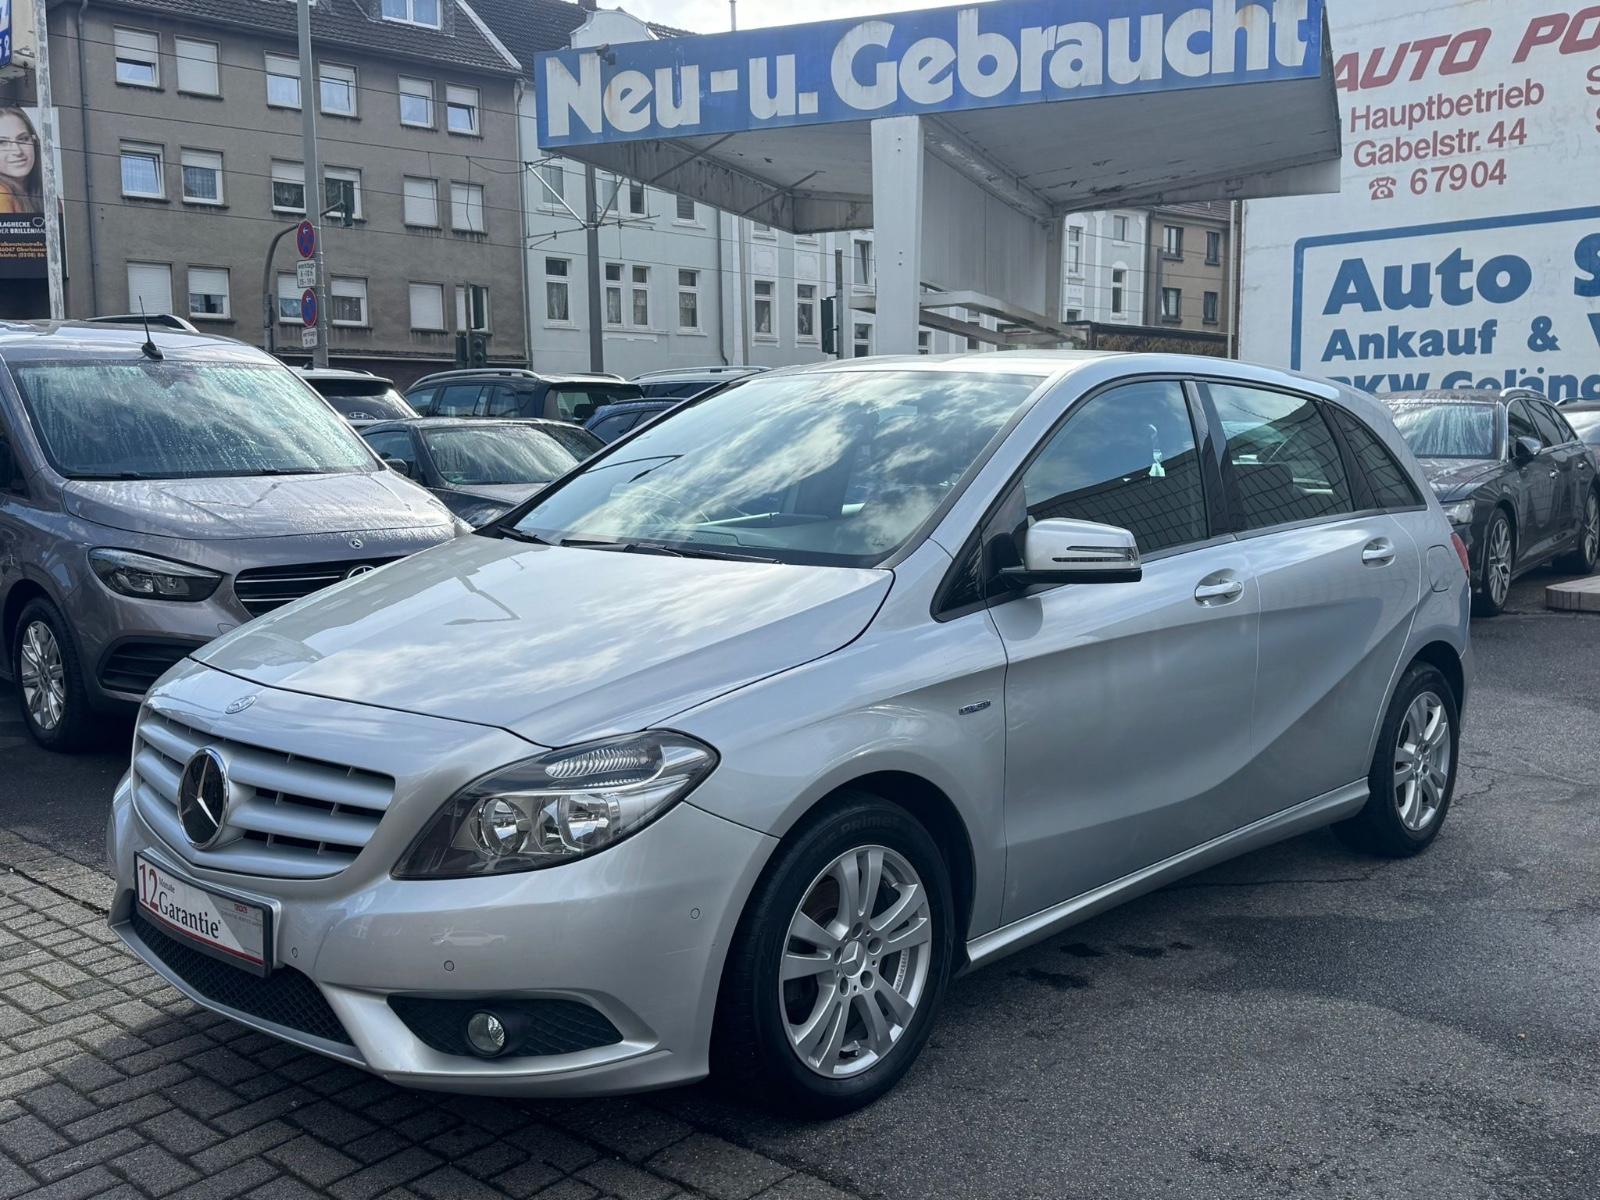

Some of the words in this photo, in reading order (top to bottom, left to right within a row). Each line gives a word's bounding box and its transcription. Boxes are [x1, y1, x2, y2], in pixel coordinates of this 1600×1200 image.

[830, 0, 1309, 110] Gebraucht
[1335, 27, 1492, 92] AUTO
[1349, 78, 1545, 133] Hauptbetrieb
[1353, 130, 1481, 168] Gabelstr.
[1486, 117, 1528, 149] 44
[1409, 158, 1507, 196] 67904
[1321, 247, 1532, 316] Auto
[1320, 318, 1498, 363] Ankauf
[1527, 314, 1561, 353] &
[138, 863, 159, 913] 12
